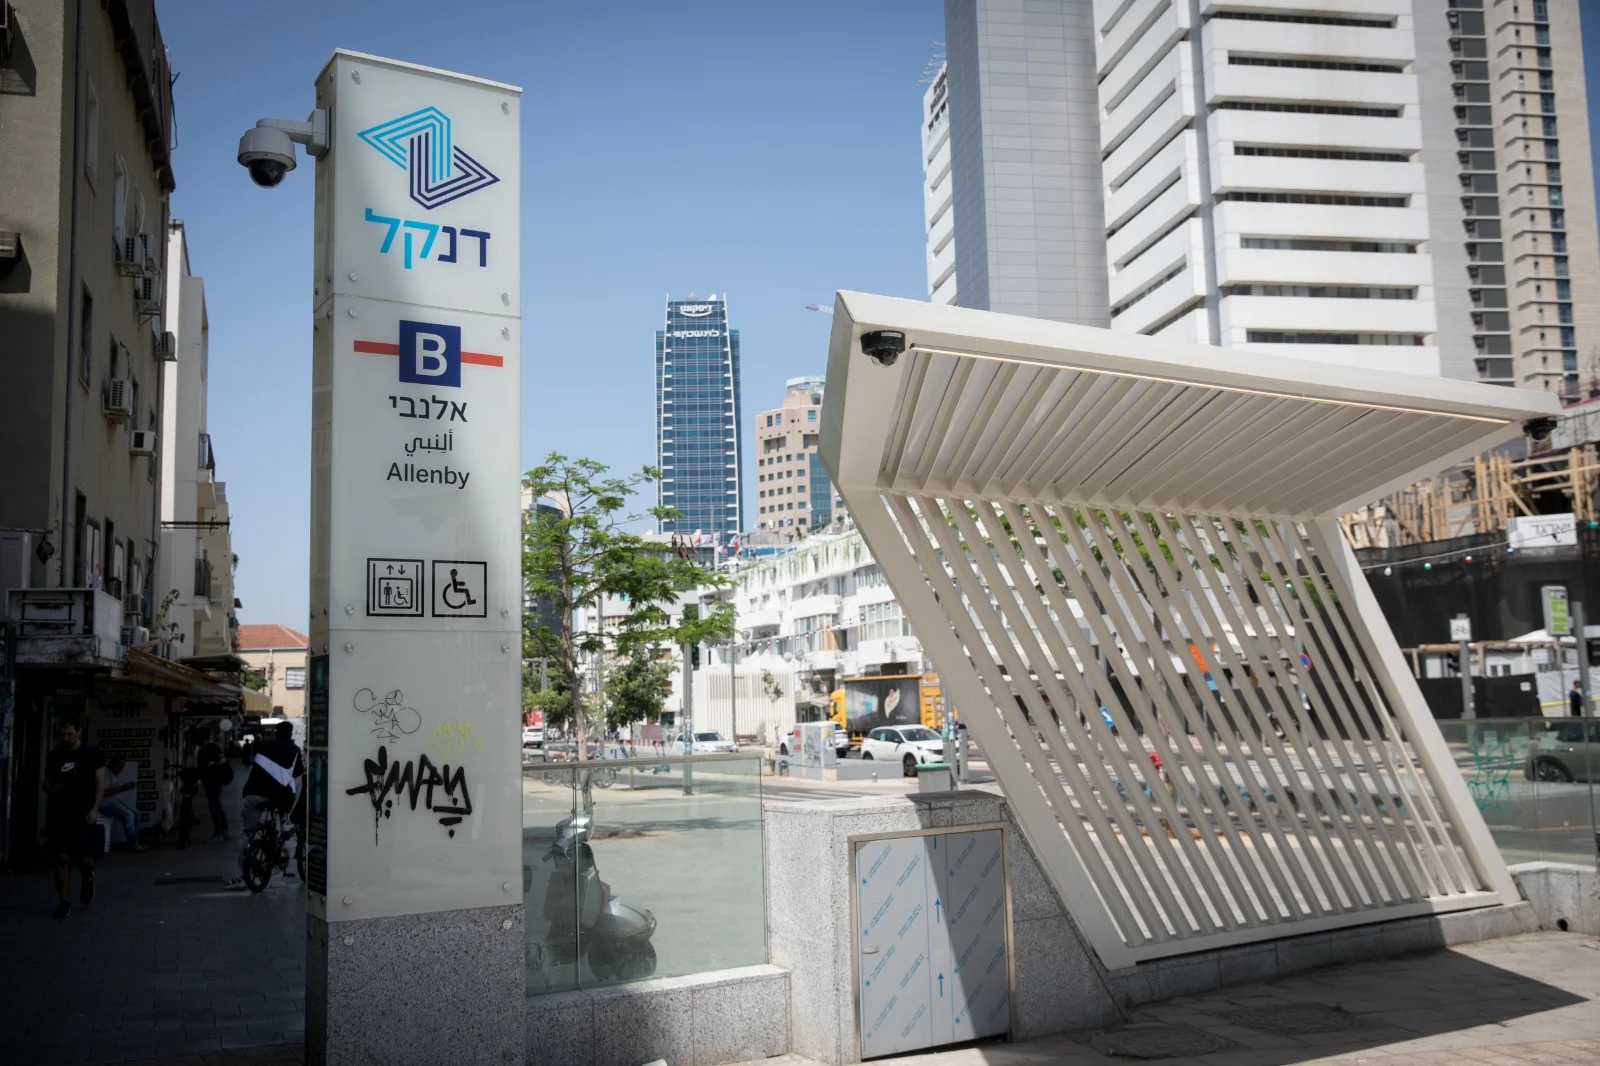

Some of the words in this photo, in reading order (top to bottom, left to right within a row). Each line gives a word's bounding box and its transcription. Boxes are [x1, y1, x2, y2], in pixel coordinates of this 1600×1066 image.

[365, 207, 491, 269] דנקל
[415, 331, 448, 377] B
[389, 395, 468, 422] אלנבי
[386, 462, 470, 490] Allenby
